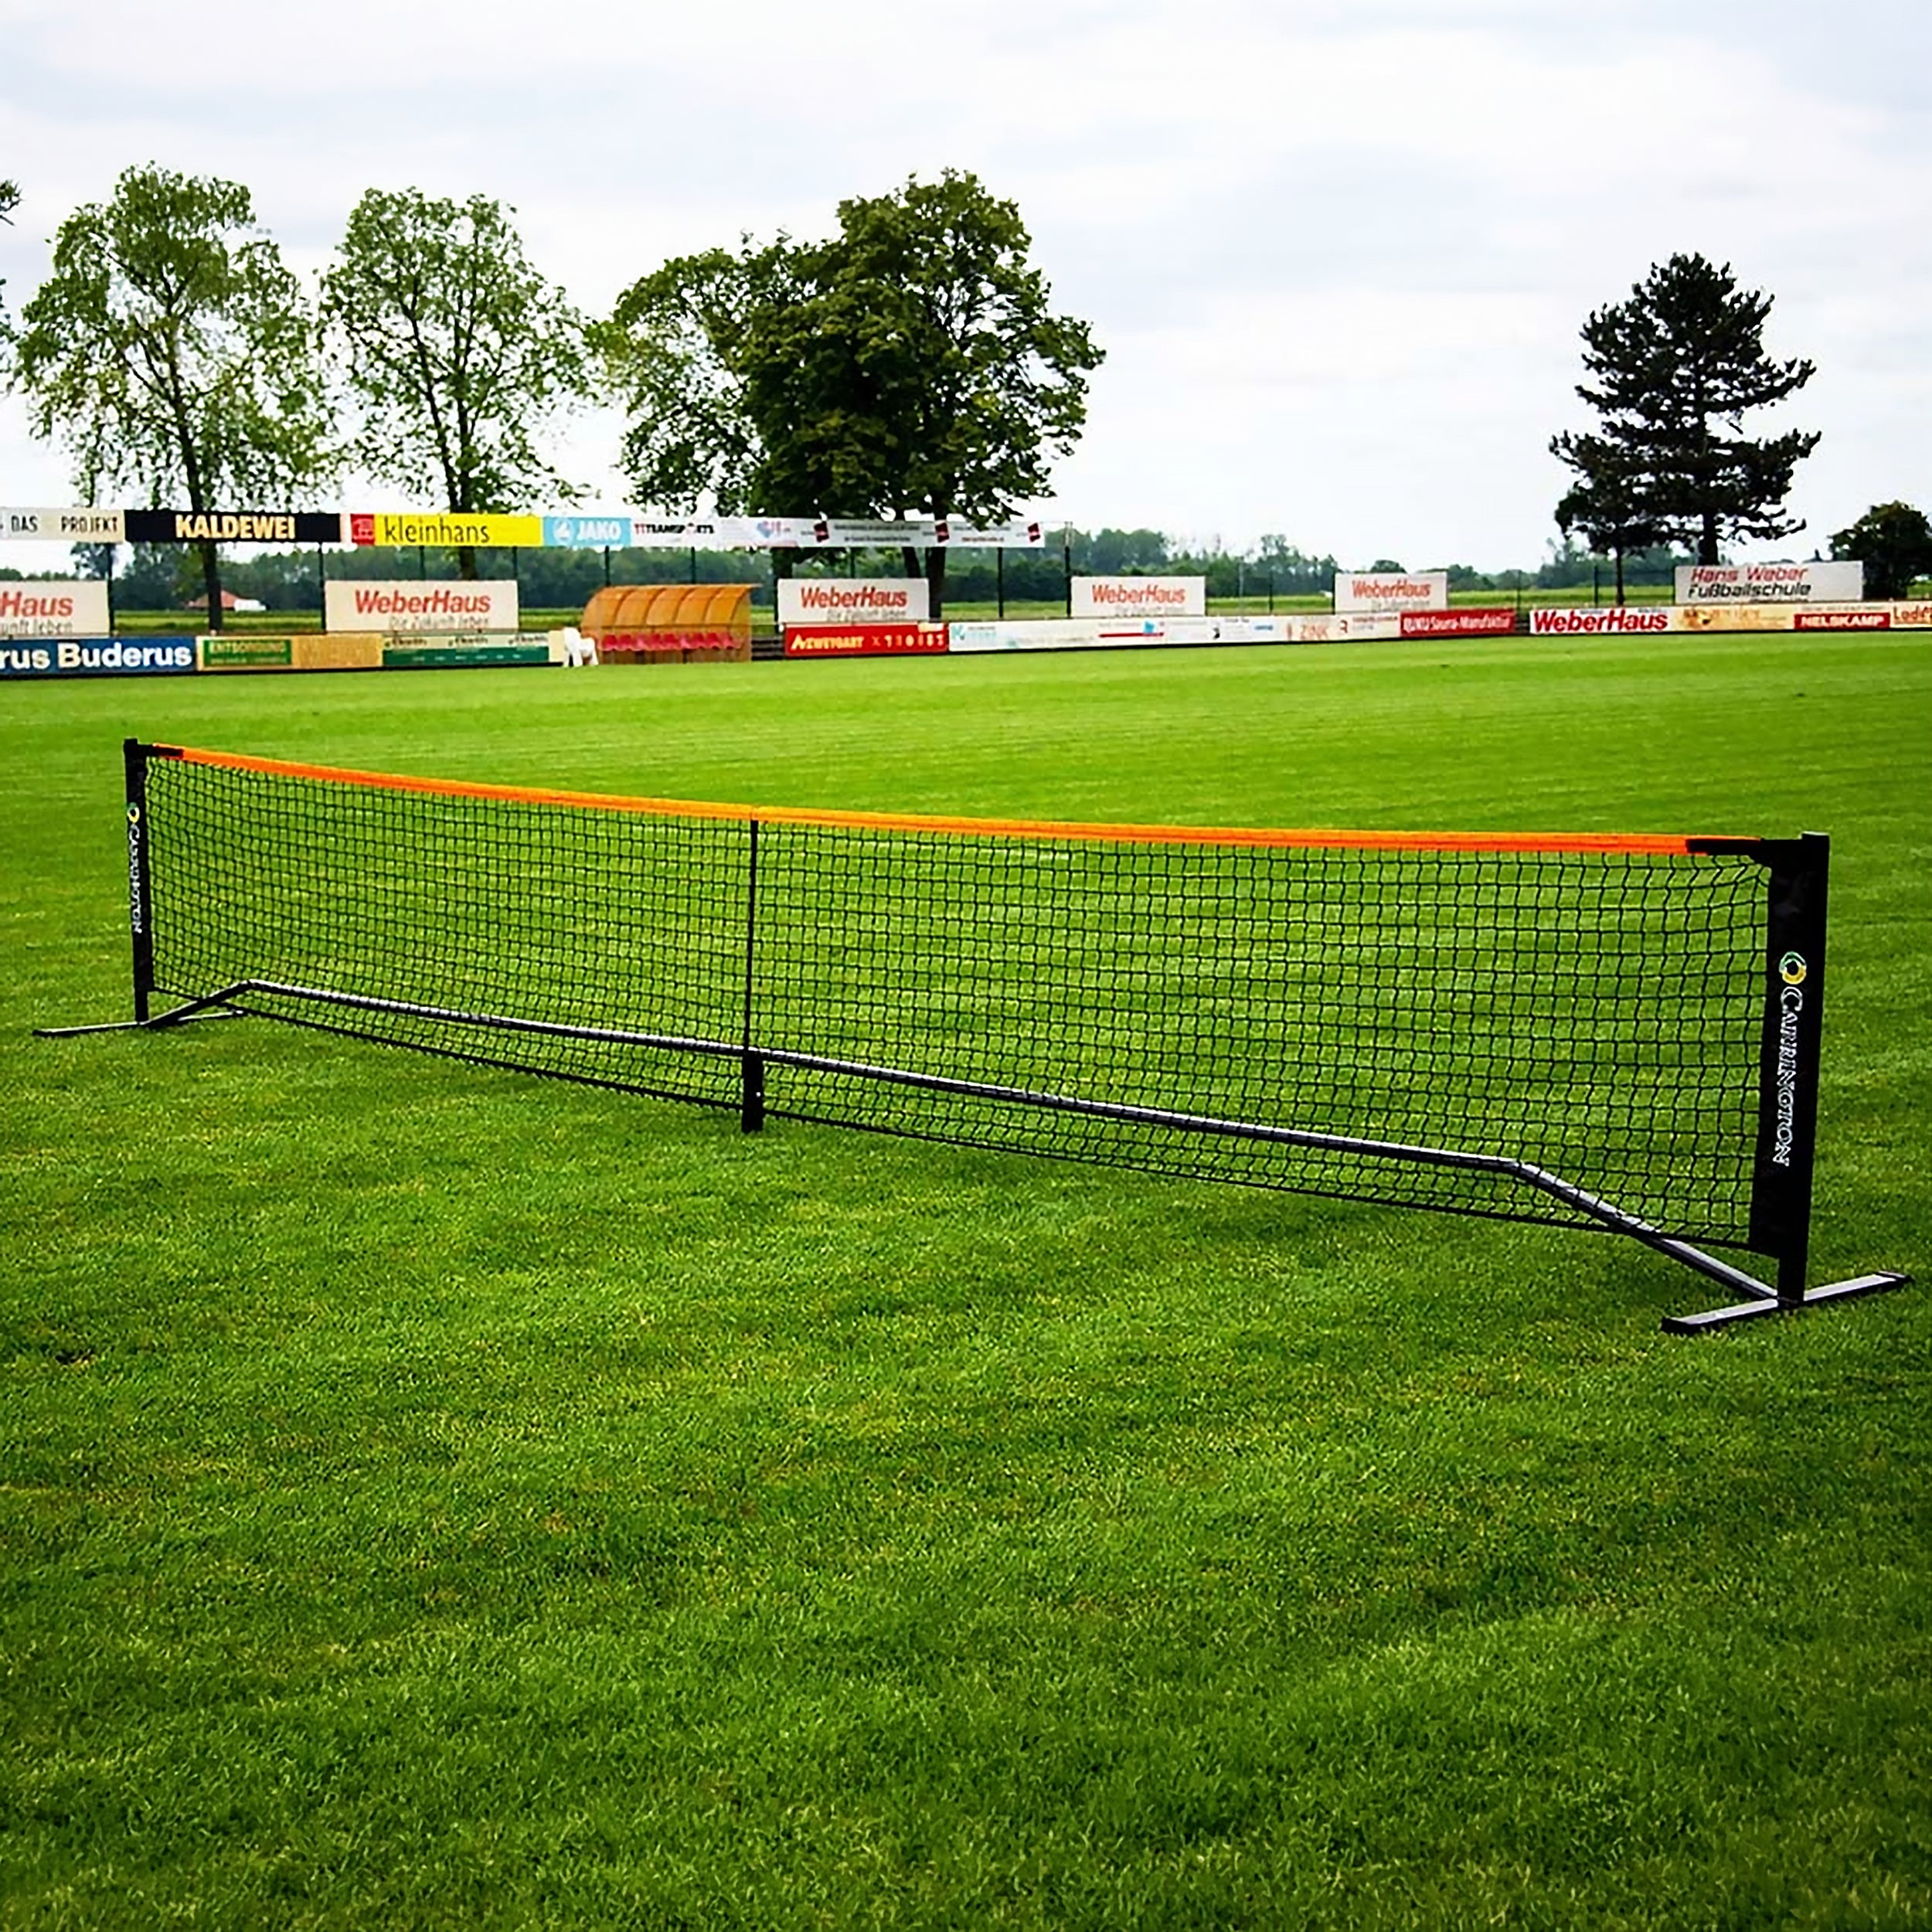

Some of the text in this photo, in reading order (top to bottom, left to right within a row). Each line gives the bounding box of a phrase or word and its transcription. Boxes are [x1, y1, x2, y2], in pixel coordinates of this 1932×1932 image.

[175, 515, 296, 539] KALDEWEI
[384, 516, 491, 543] kleinhans
[577, 521, 621, 541] JAKO
[1692, 567, 1808, 583] Hans Weber
[801, 587, 907, 608] WeberHaus
[1092, 584, 1185, 604] WeberHaus
[1352, 580, 1431, 598] WeberHaus
[1688, 582, 1811, 598] Fußballschule
[354, 590, 492, 614] WeberHaus
[1534, 609, 1668, 632] WeberHaus
[57, 641, 192, 668] Buderus
[1773, 986, 1803, 1166] CARRINGTON
